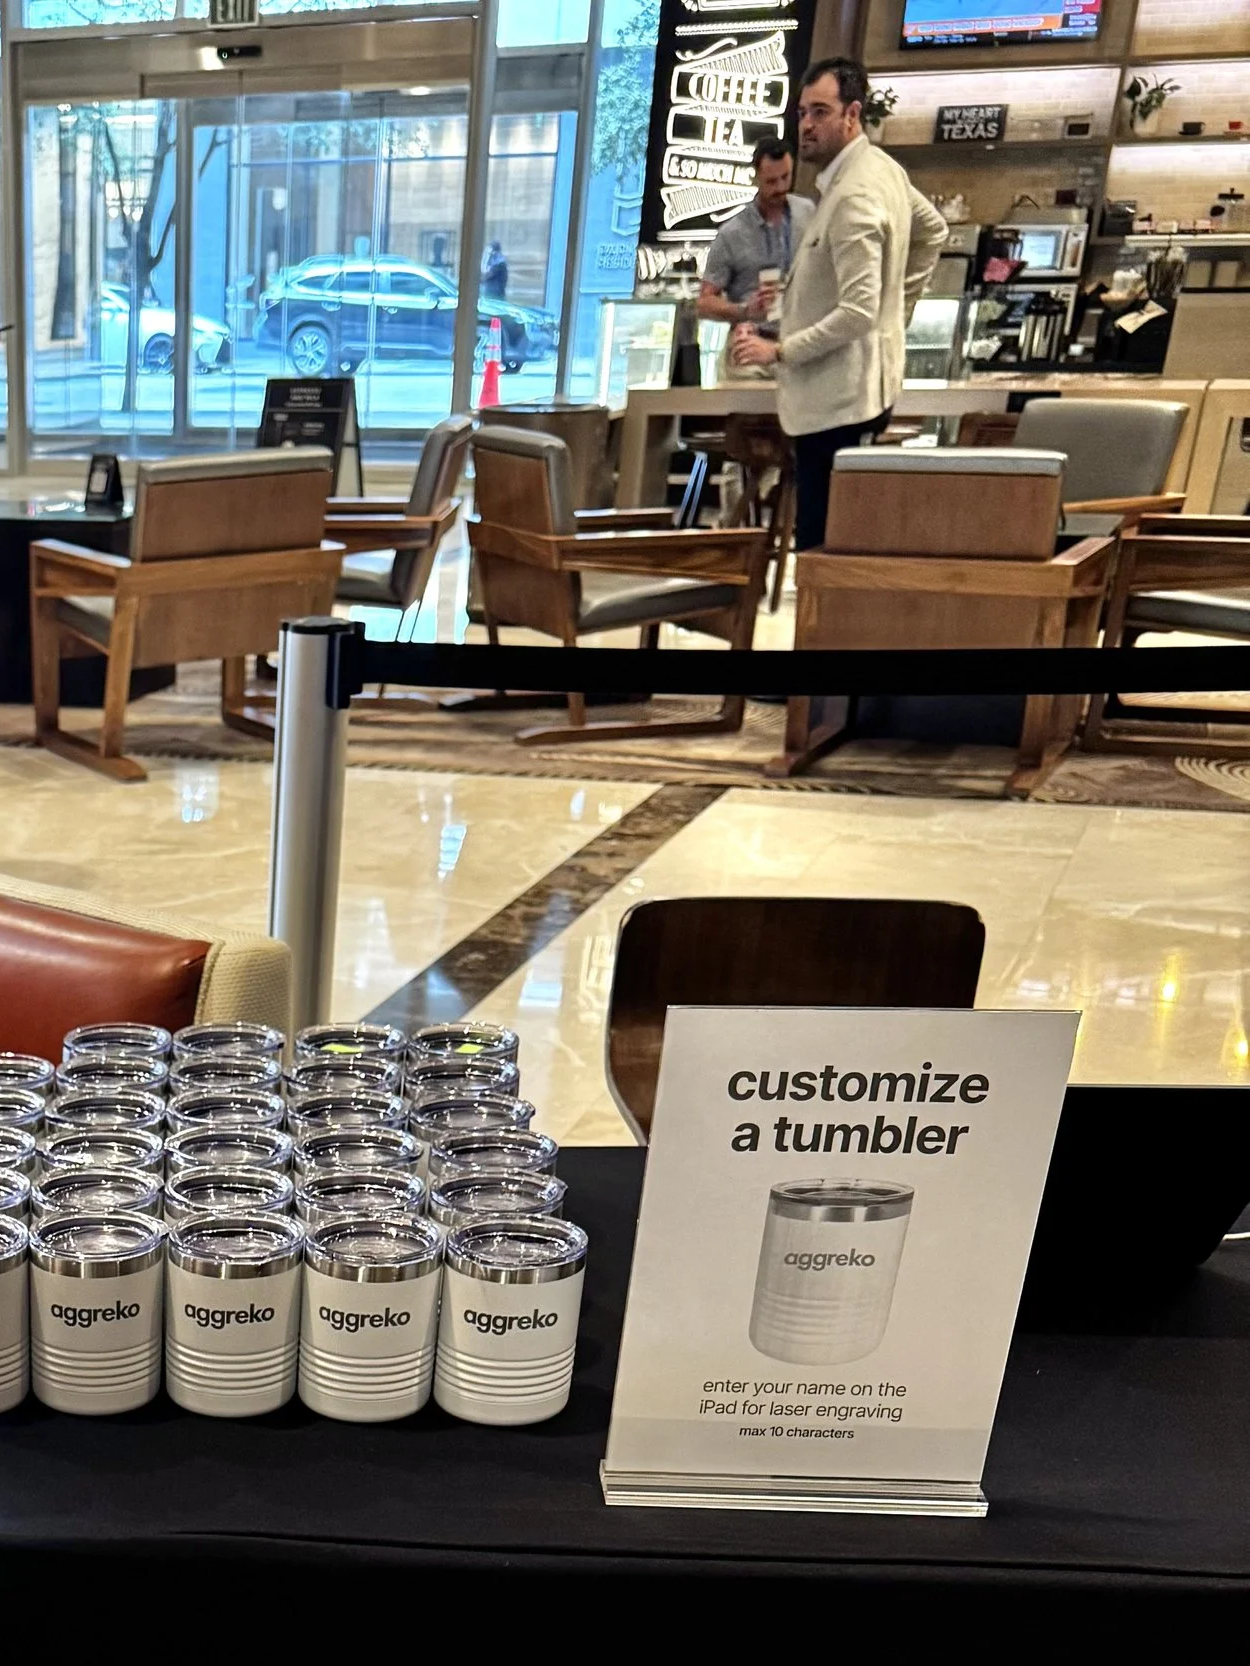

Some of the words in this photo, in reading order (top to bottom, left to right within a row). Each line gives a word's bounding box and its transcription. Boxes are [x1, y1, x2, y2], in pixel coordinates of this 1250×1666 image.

[688, 73, 772, 108] COFFEE
[703, 115, 744, 147] TEA
[940, 121, 1000, 140] TEXAS
[728, 1061, 990, 1105] customize
[731, 1122, 760, 1153] a
[774, 1116, 969, 1155] tumbler
[784, 1248, 876, 1271] aggreko
[51, 1300, 140, 1328] aggreko
[184, 1303, 275, 1329] aggreko
[319, 1305, 411, 1332] aggreko
[463, 1308, 558, 1335] aggreko
[703, 1379, 749, 1394] enter
[753, 1382, 793, 1396] your
[796, 1383, 846, 1395] name
[850, 1384, 872, 1396] on
[878, 1382, 907, 1397] the
[699, 1399, 737, 1415] iPad
[742, 1399, 766, 1415] for
[769, 1401, 812, 1416] laser
[816, 1403, 903, 1422] engraving
[739, 1427, 766, 1437] max
[770, 1426, 784, 1437] 10
[786, 1426, 855, 1439] characters
